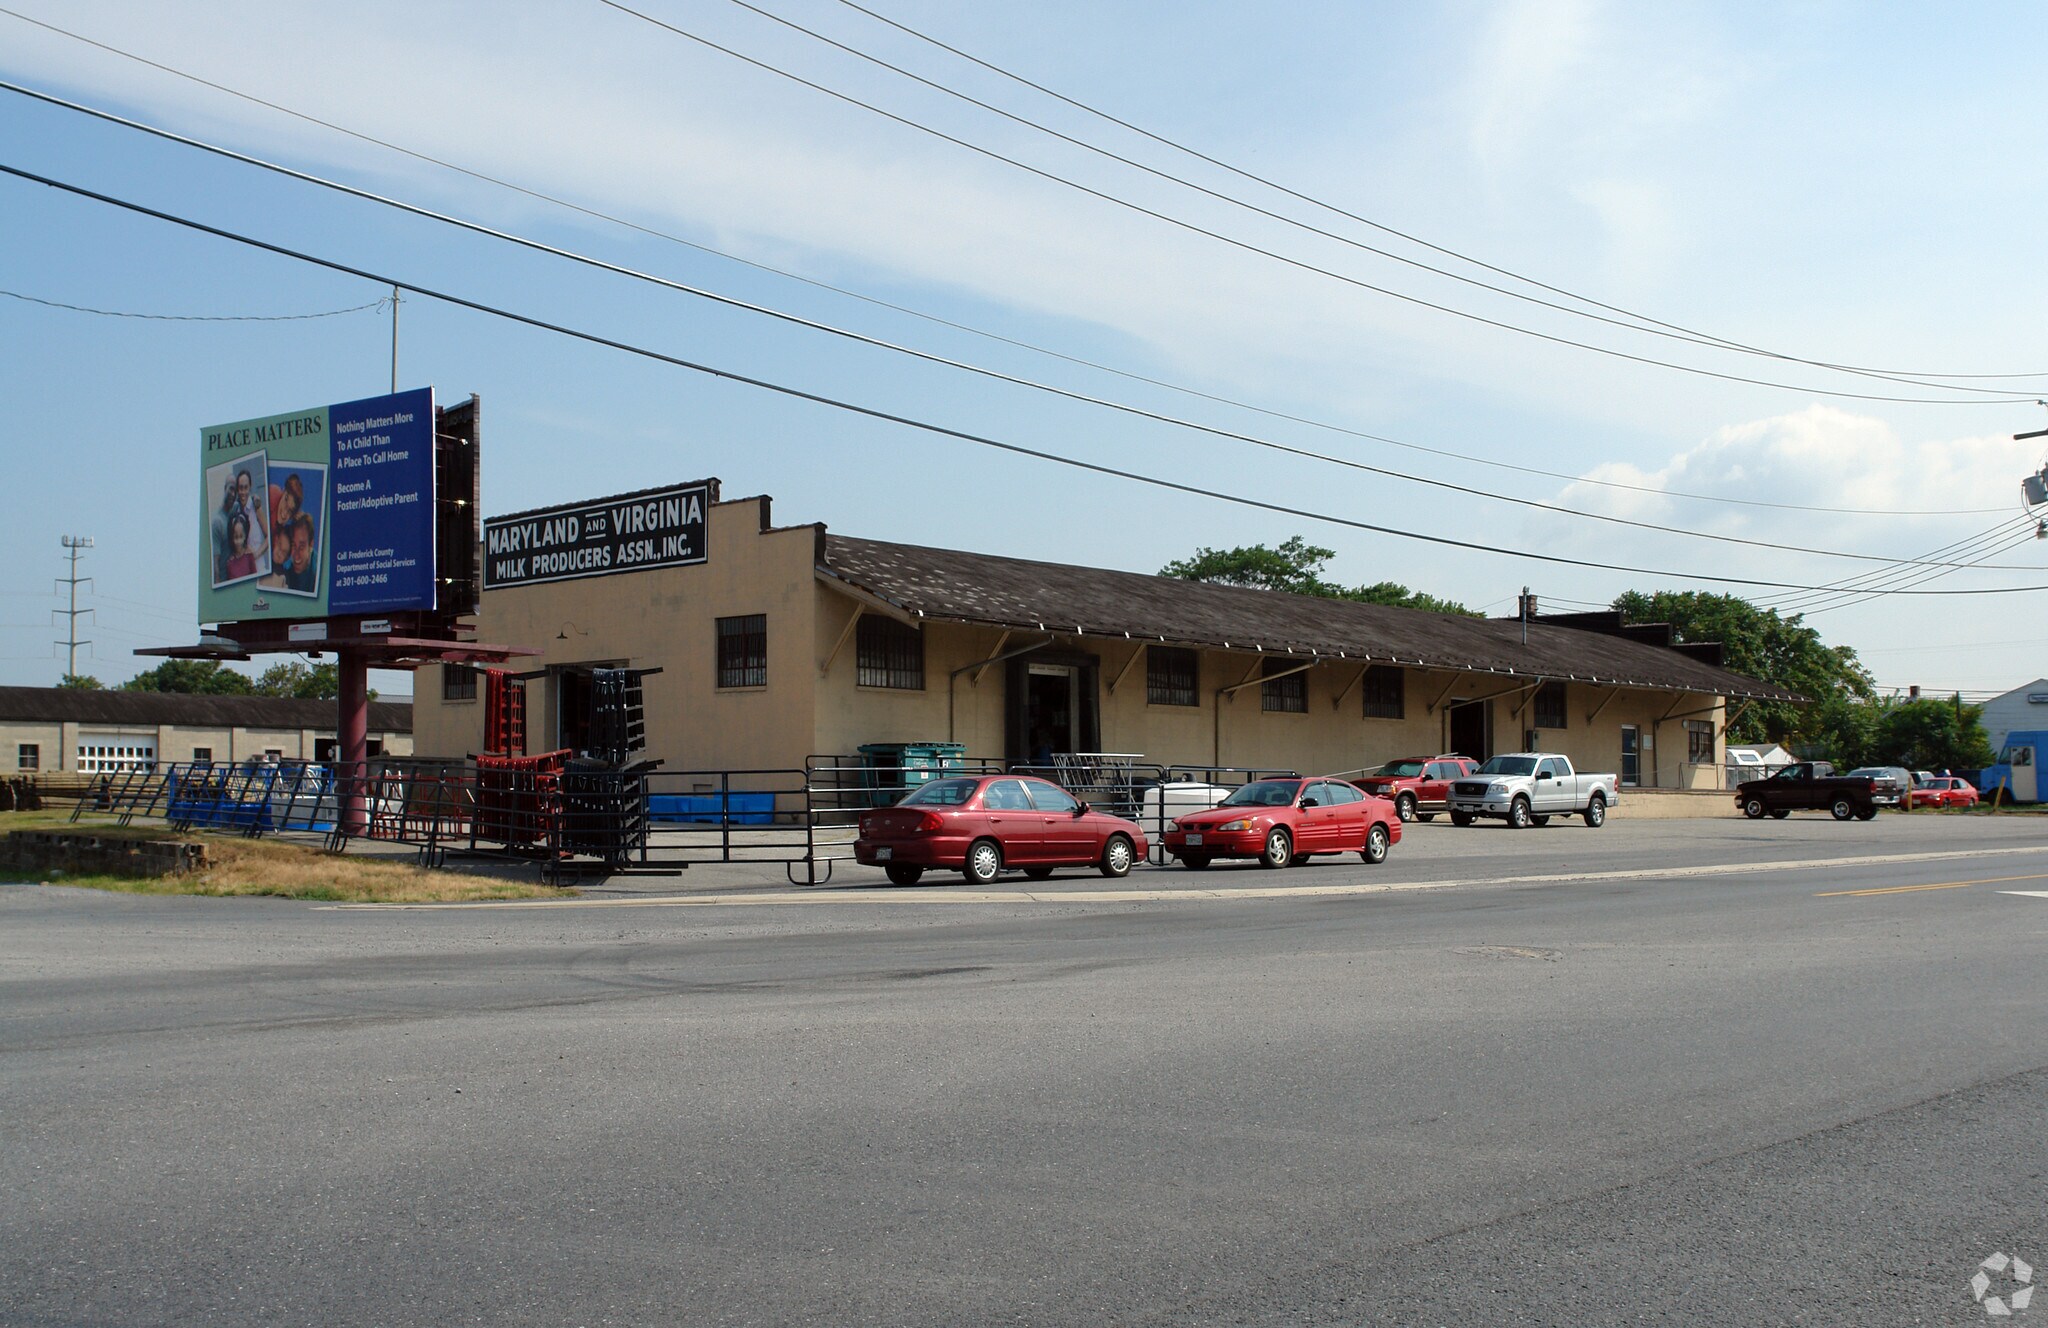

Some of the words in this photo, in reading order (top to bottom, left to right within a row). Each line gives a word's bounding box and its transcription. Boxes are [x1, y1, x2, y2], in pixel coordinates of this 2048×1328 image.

[337, 421, 365, 433] Nothing
[366, 416, 394, 429] Matters
[394, 413, 413, 424] More
[208, 428, 250, 451] PLACE
[255, 415, 321, 443] MATTERS
[337, 440, 346, 452] To
[346, 439, 353, 450] A
[353, 436, 372, 449] Child
[372, 435, 390, 445] Than
[337, 458, 343, 469] A
[343, 456, 362, 468] Place
[363, 454, 372, 465] To
[372, 451, 387, 464] Call
[387, 450, 409, 461] Home
[337, 483, 364, 493] Become
[365, 479, 372, 490] A
[337, 495, 393, 511] Foster/Adoptive
[394, 492, 418, 504] Parent
[488, 516, 579, 556] MARYLAND
[585, 518, 606, 533] AND
[611, 495, 703, 536] VIRGINIA
[336, 551, 348, 561] Call
[348, 549, 374, 560] Frederick
[374, 548, 394, 558] County
[496, 556, 526, 580] MILK
[532, 546, 611, 575] PRODUCERS
[662, 533, 692, 558] INC.
[336, 563, 369, 573] Department
[369, 560, 376, 570] of
[376, 560, 392, 569] Social
[393, 558, 416, 568] Services
[336, 579, 342, 587] at
